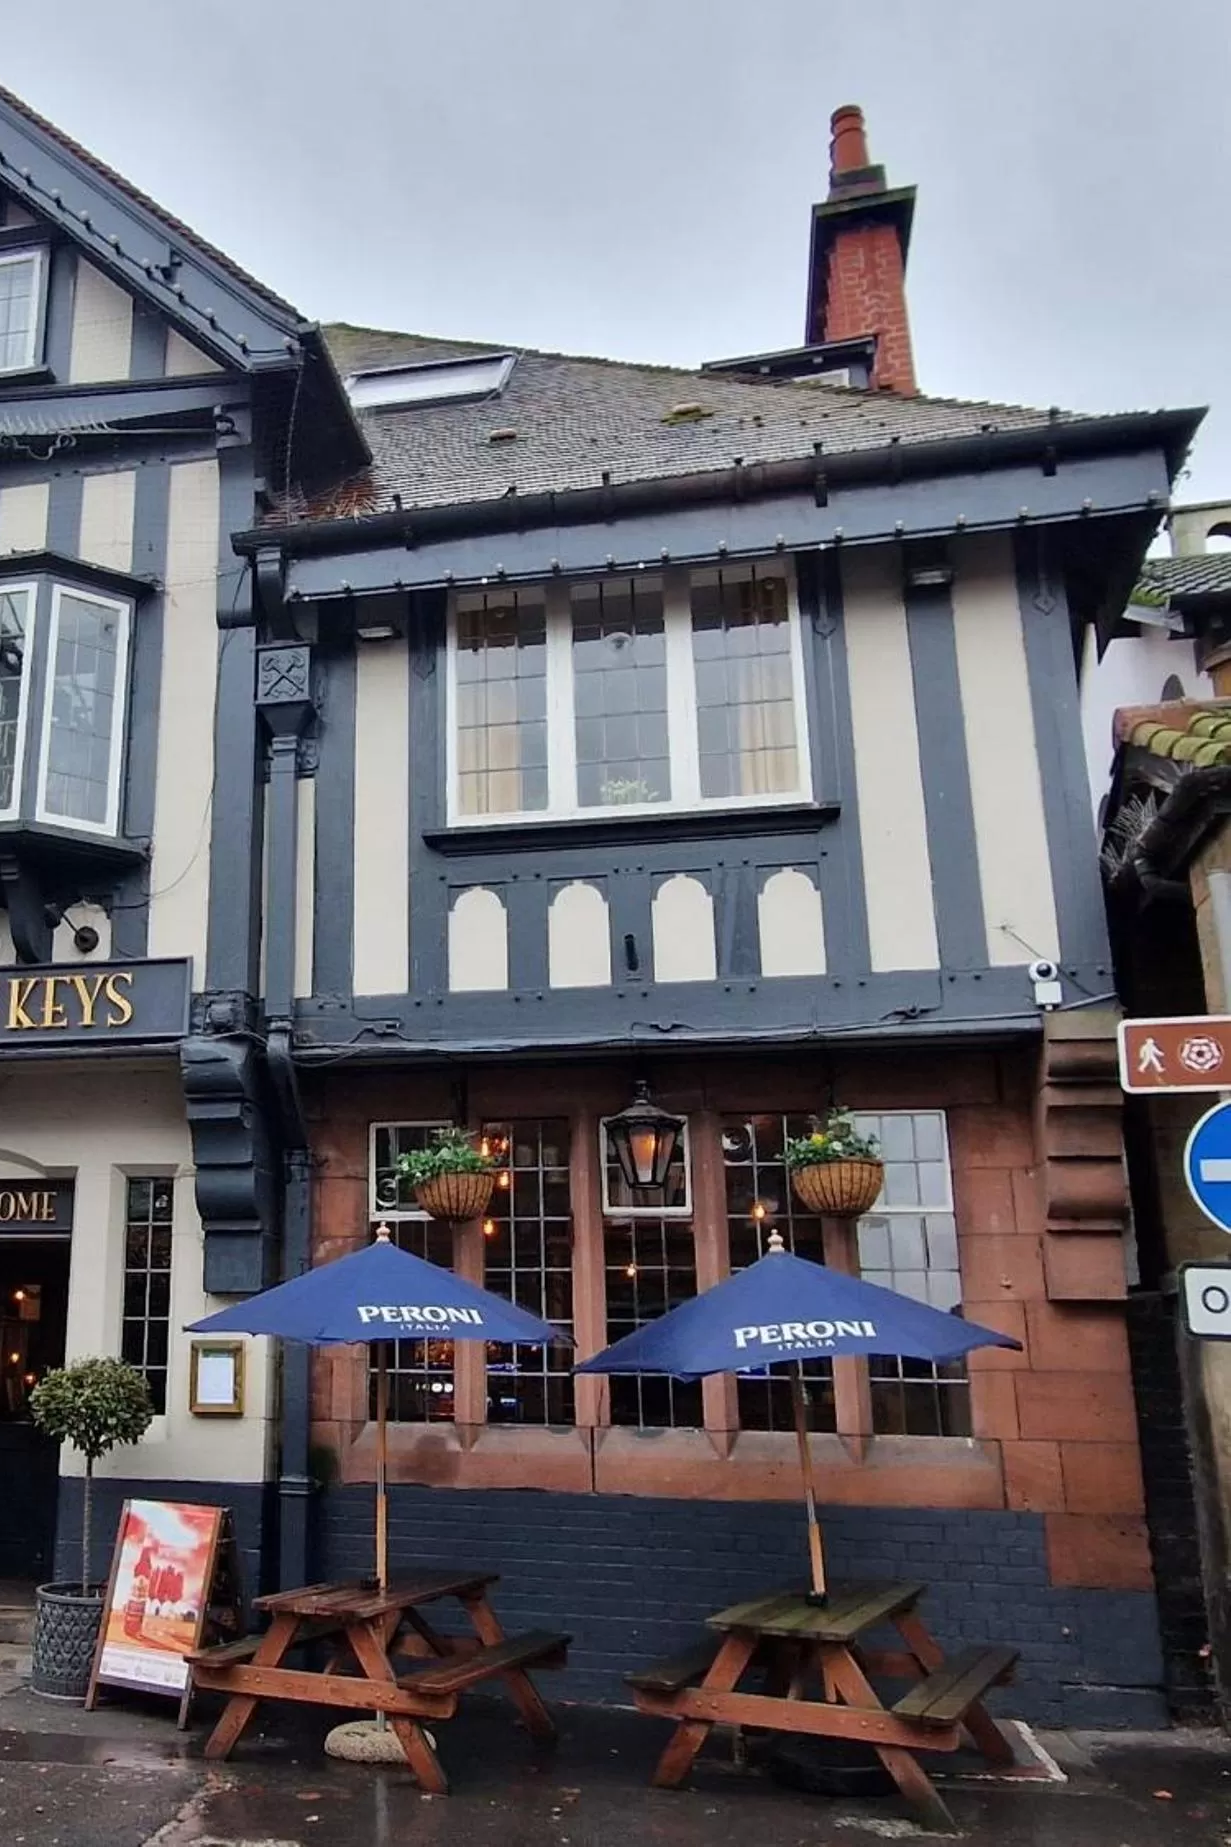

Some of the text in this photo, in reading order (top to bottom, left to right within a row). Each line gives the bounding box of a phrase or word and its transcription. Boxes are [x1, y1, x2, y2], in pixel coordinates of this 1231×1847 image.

[4, 972, 135, 1029] KEYS
[357, 1306, 484, 1325] PERONI
[399, 1323, 451, 1331] ITALIA
[734, 1320, 877, 1348] PERONI
[778, 1339, 835, 1351] ITALIA
